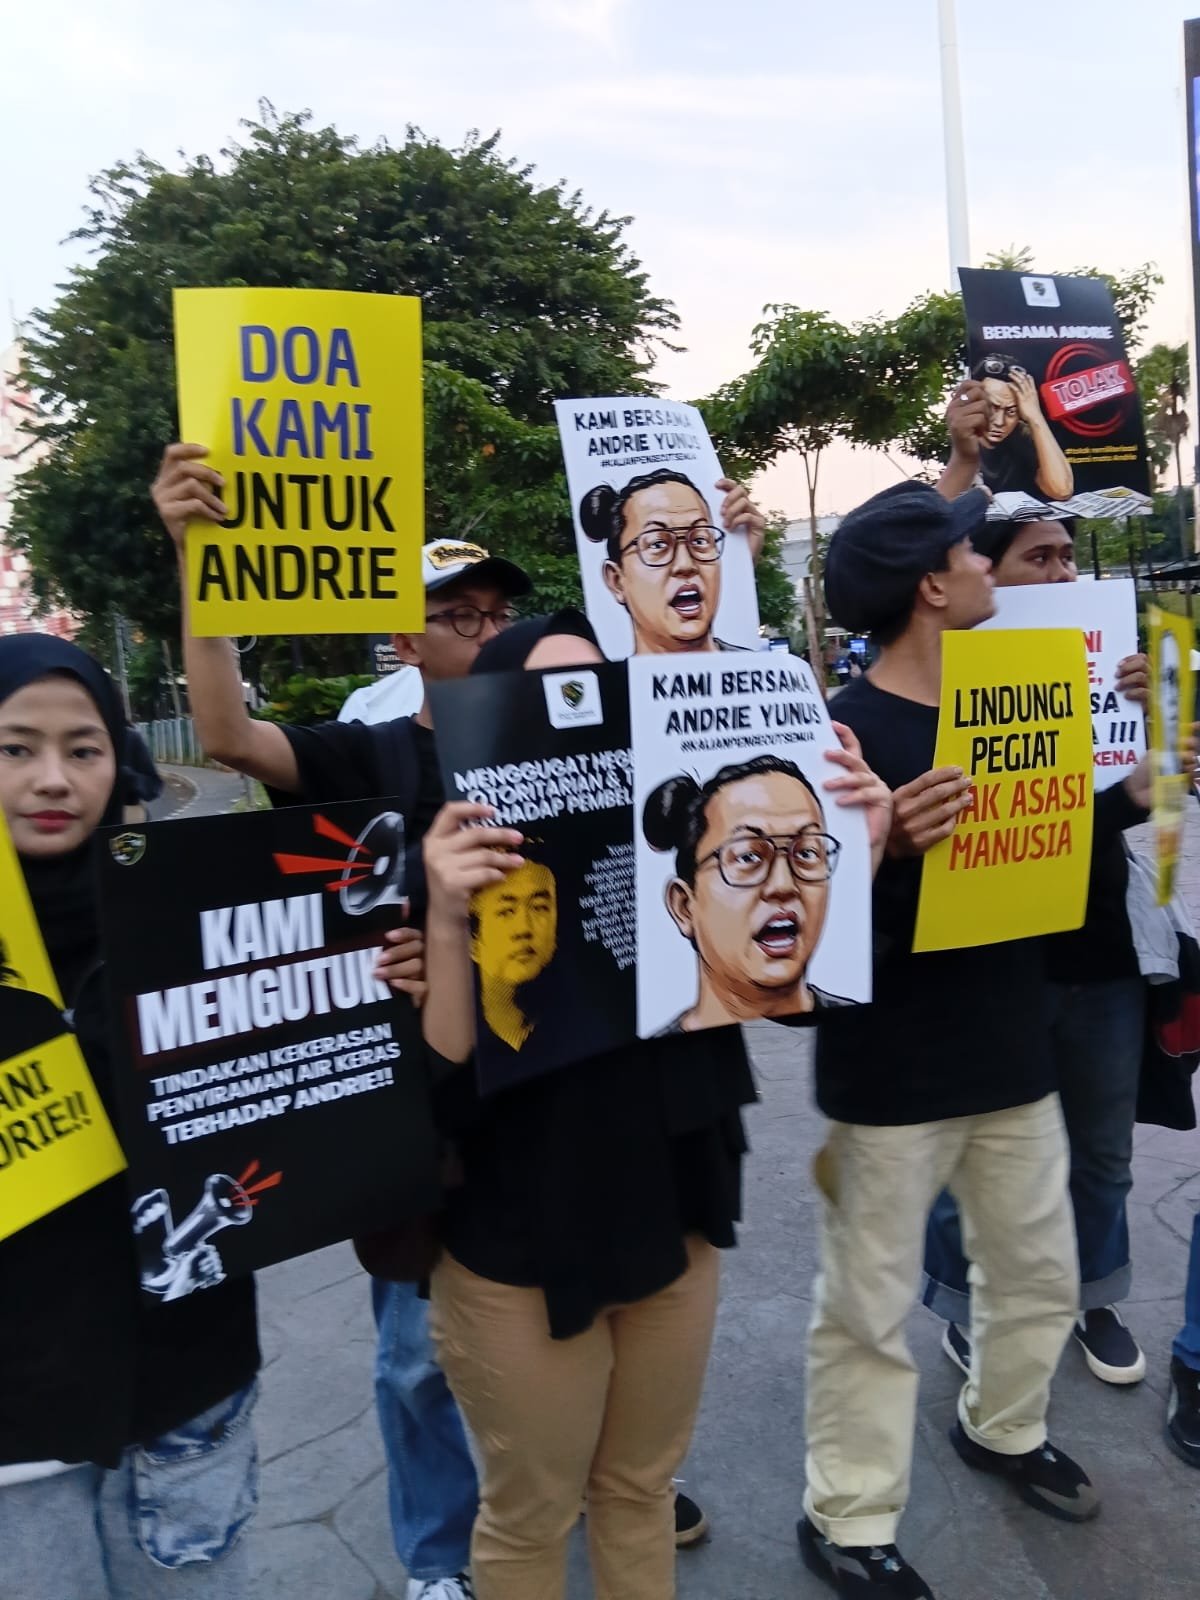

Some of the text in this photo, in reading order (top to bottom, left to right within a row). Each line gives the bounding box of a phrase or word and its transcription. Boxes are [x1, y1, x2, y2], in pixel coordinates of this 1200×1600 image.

[240, 325, 361, 387] DOA
[982, 325, 1114, 339] BERSAMA ANDRIE
[1050, 364, 1127, 404] TOLAK
[231, 398, 374, 460] KAMI
[574, 409, 692, 431] KAMI BERSAMA
[588, 431, 702, 457] ANDRIE YUNUS
[197, 544, 399, 602] ANDRIE
[652, 669, 813, 700] KAMI BERSAMA
[953, 682, 1073, 728] LINDUNGI
[665, 702, 822, 735] ANDRIE YUNUS
[453, 754, 590, 793] MENGGUGAT
[970, 730, 1060, 776] PEGIAT
[466, 770, 604, 806] OTORITARIAN
[944, 773, 1087, 825] AK ASASI
[949, 820, 1072, 871] MANUSIA
[200, 892, 325, 971] KAMI
[136, 946, 393, 1055] MENGUTUK
[147, 1042, 402, 1122] PENYIRAMAN AIR KERAS
[150, 1023, 393, 1097] TINDAKAN KEKERASAN
[161, 1066, 395, 1144] TERHADAP ANDRIE!!
